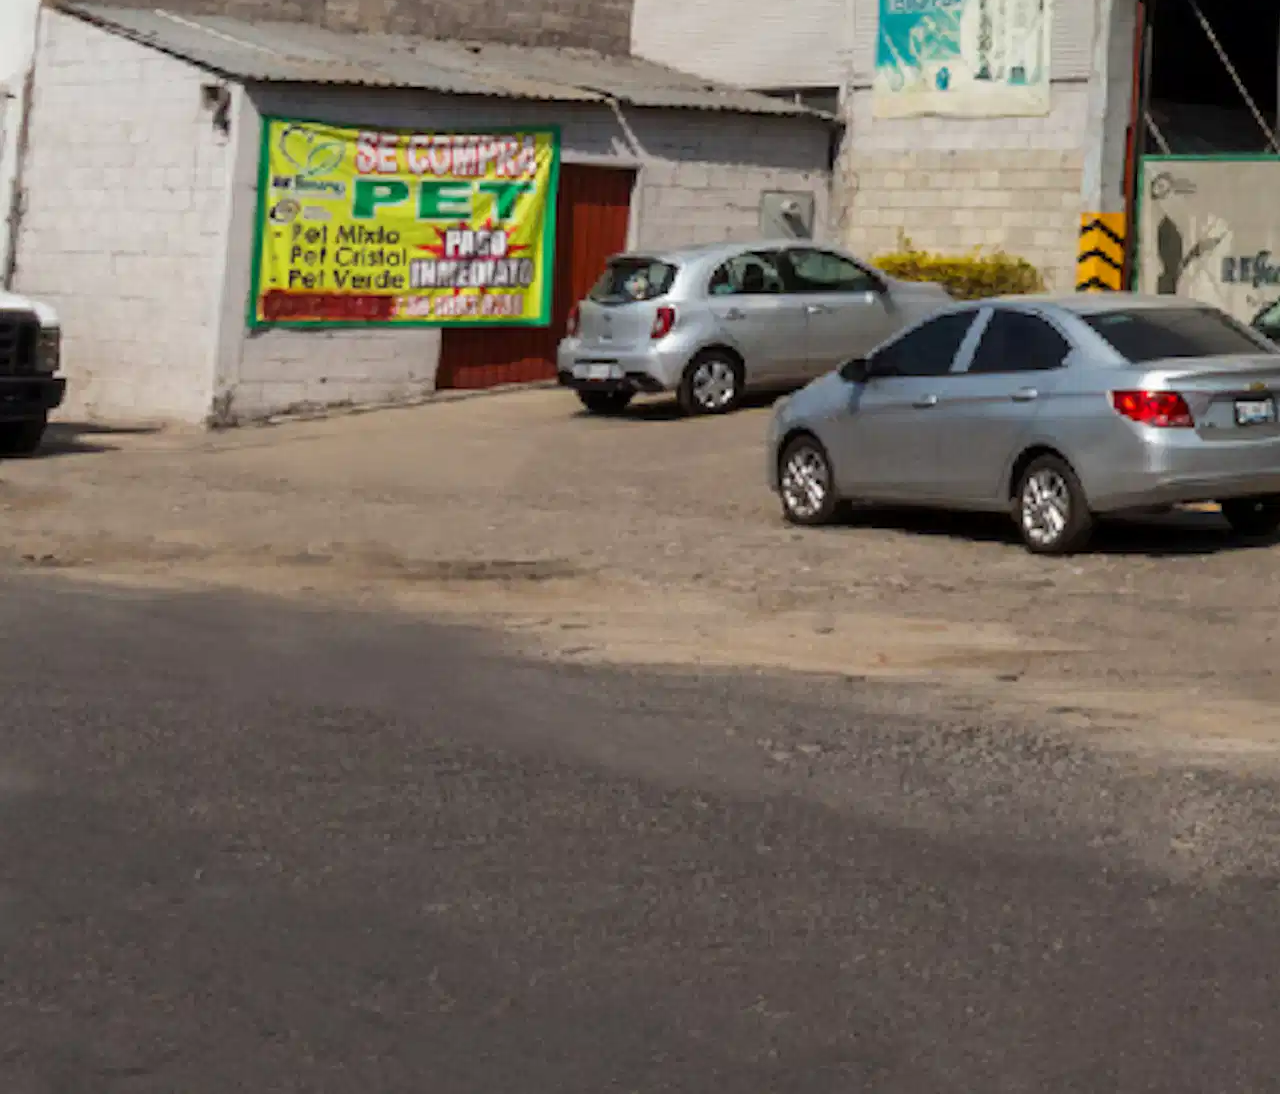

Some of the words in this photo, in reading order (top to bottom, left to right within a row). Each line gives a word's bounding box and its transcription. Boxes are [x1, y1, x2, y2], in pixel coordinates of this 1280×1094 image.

[356, 131, 399, 175] SE
[407, 133, 537, 178] COMPRA
[351, 177, 537, 221] PET
[291, 224, 328, 244] Pet
[445, 228, 507, 257] PAGO
[290, 245, 327, 265] Pet
[335, 247, 407, 267] Cristal
[287, 268, 325, 288] Pet
[332, 268, 405, 289] Verde
